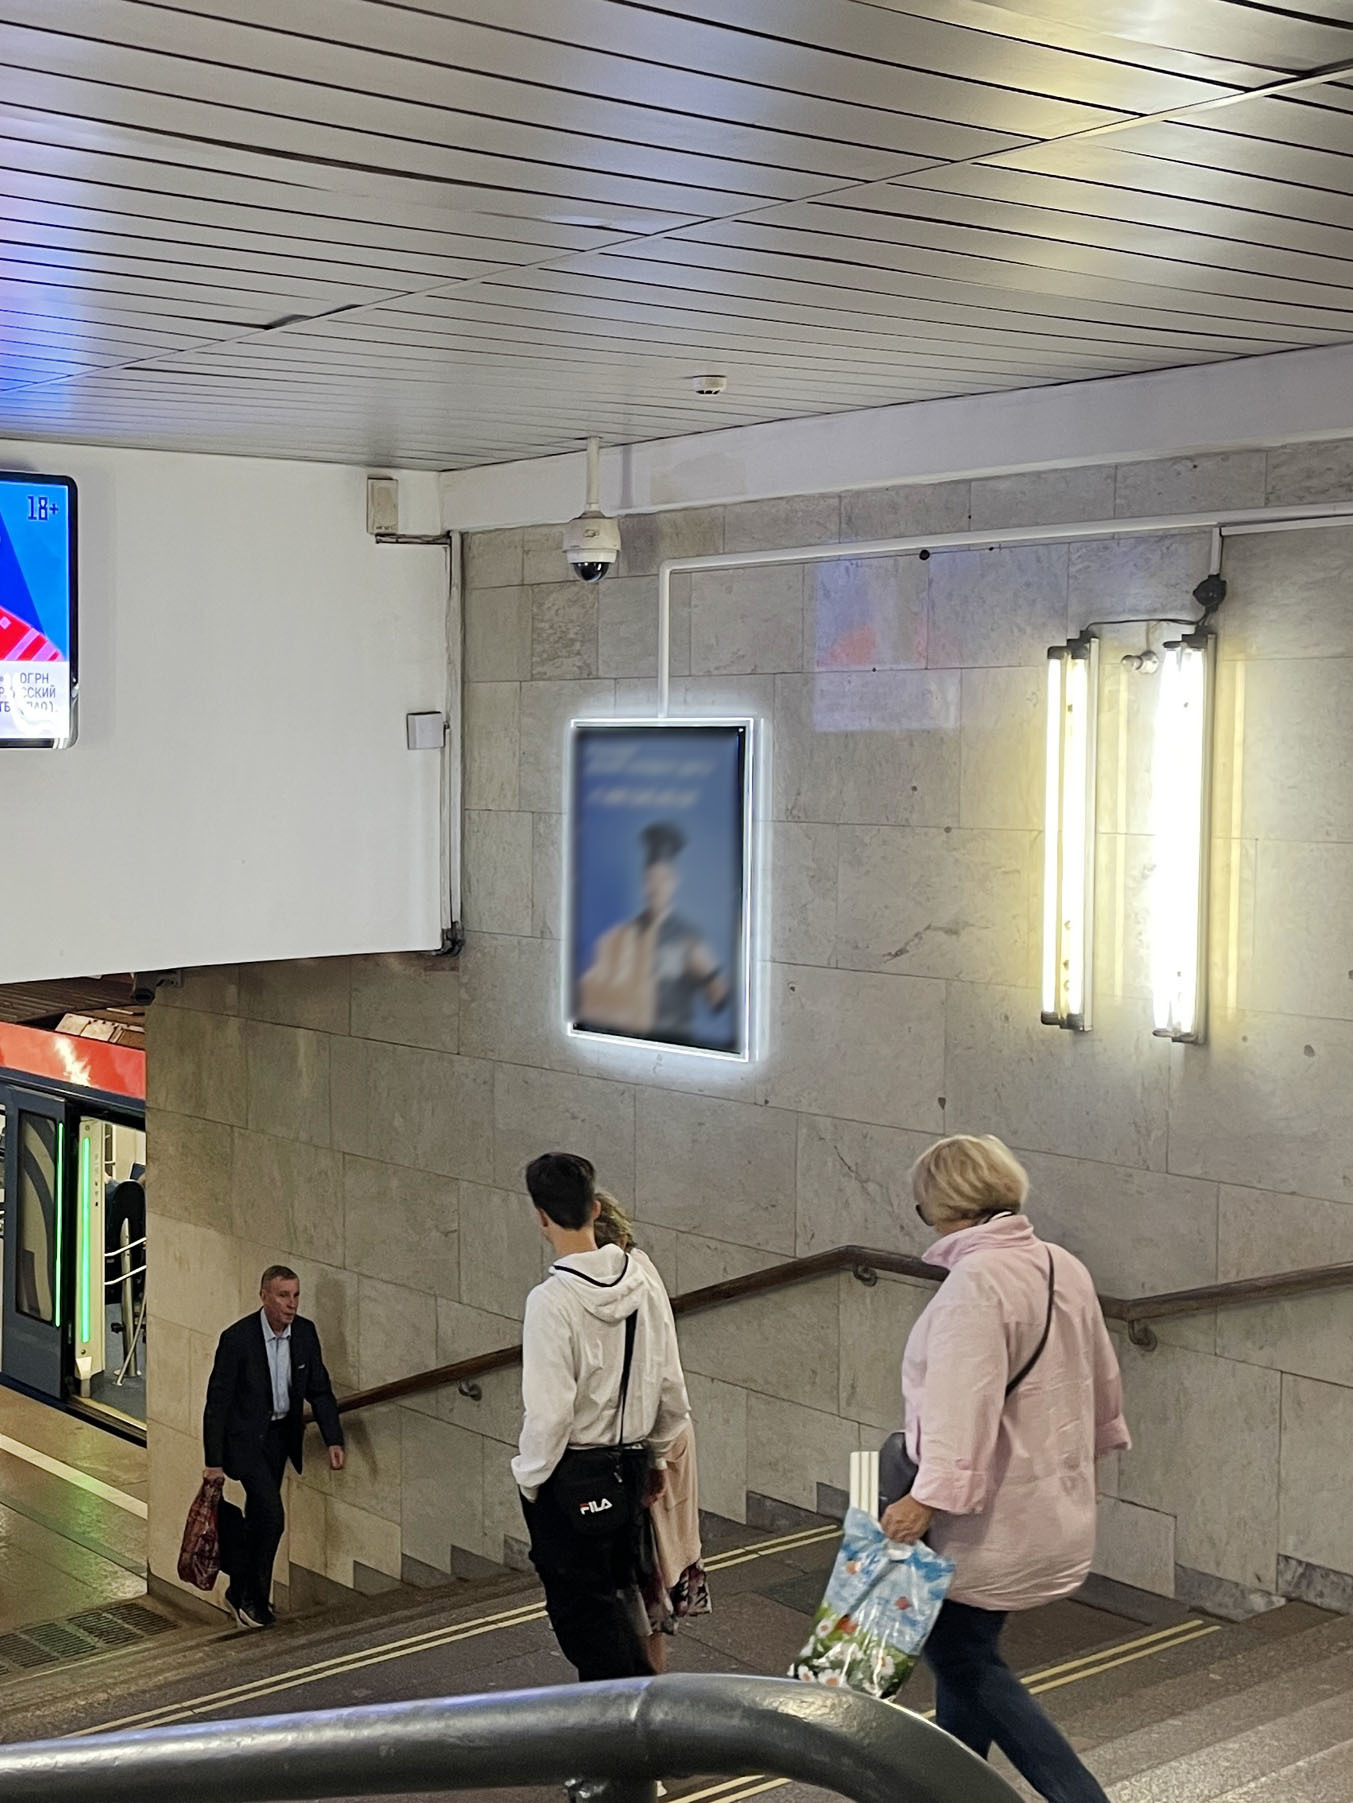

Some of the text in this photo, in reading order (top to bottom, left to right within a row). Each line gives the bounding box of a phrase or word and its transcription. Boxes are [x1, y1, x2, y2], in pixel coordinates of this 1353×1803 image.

[27, 495, 59, 521] 18+
[20, 672, 49, 684] ОГРН
[579, 1498, 613, 1516] FILA
